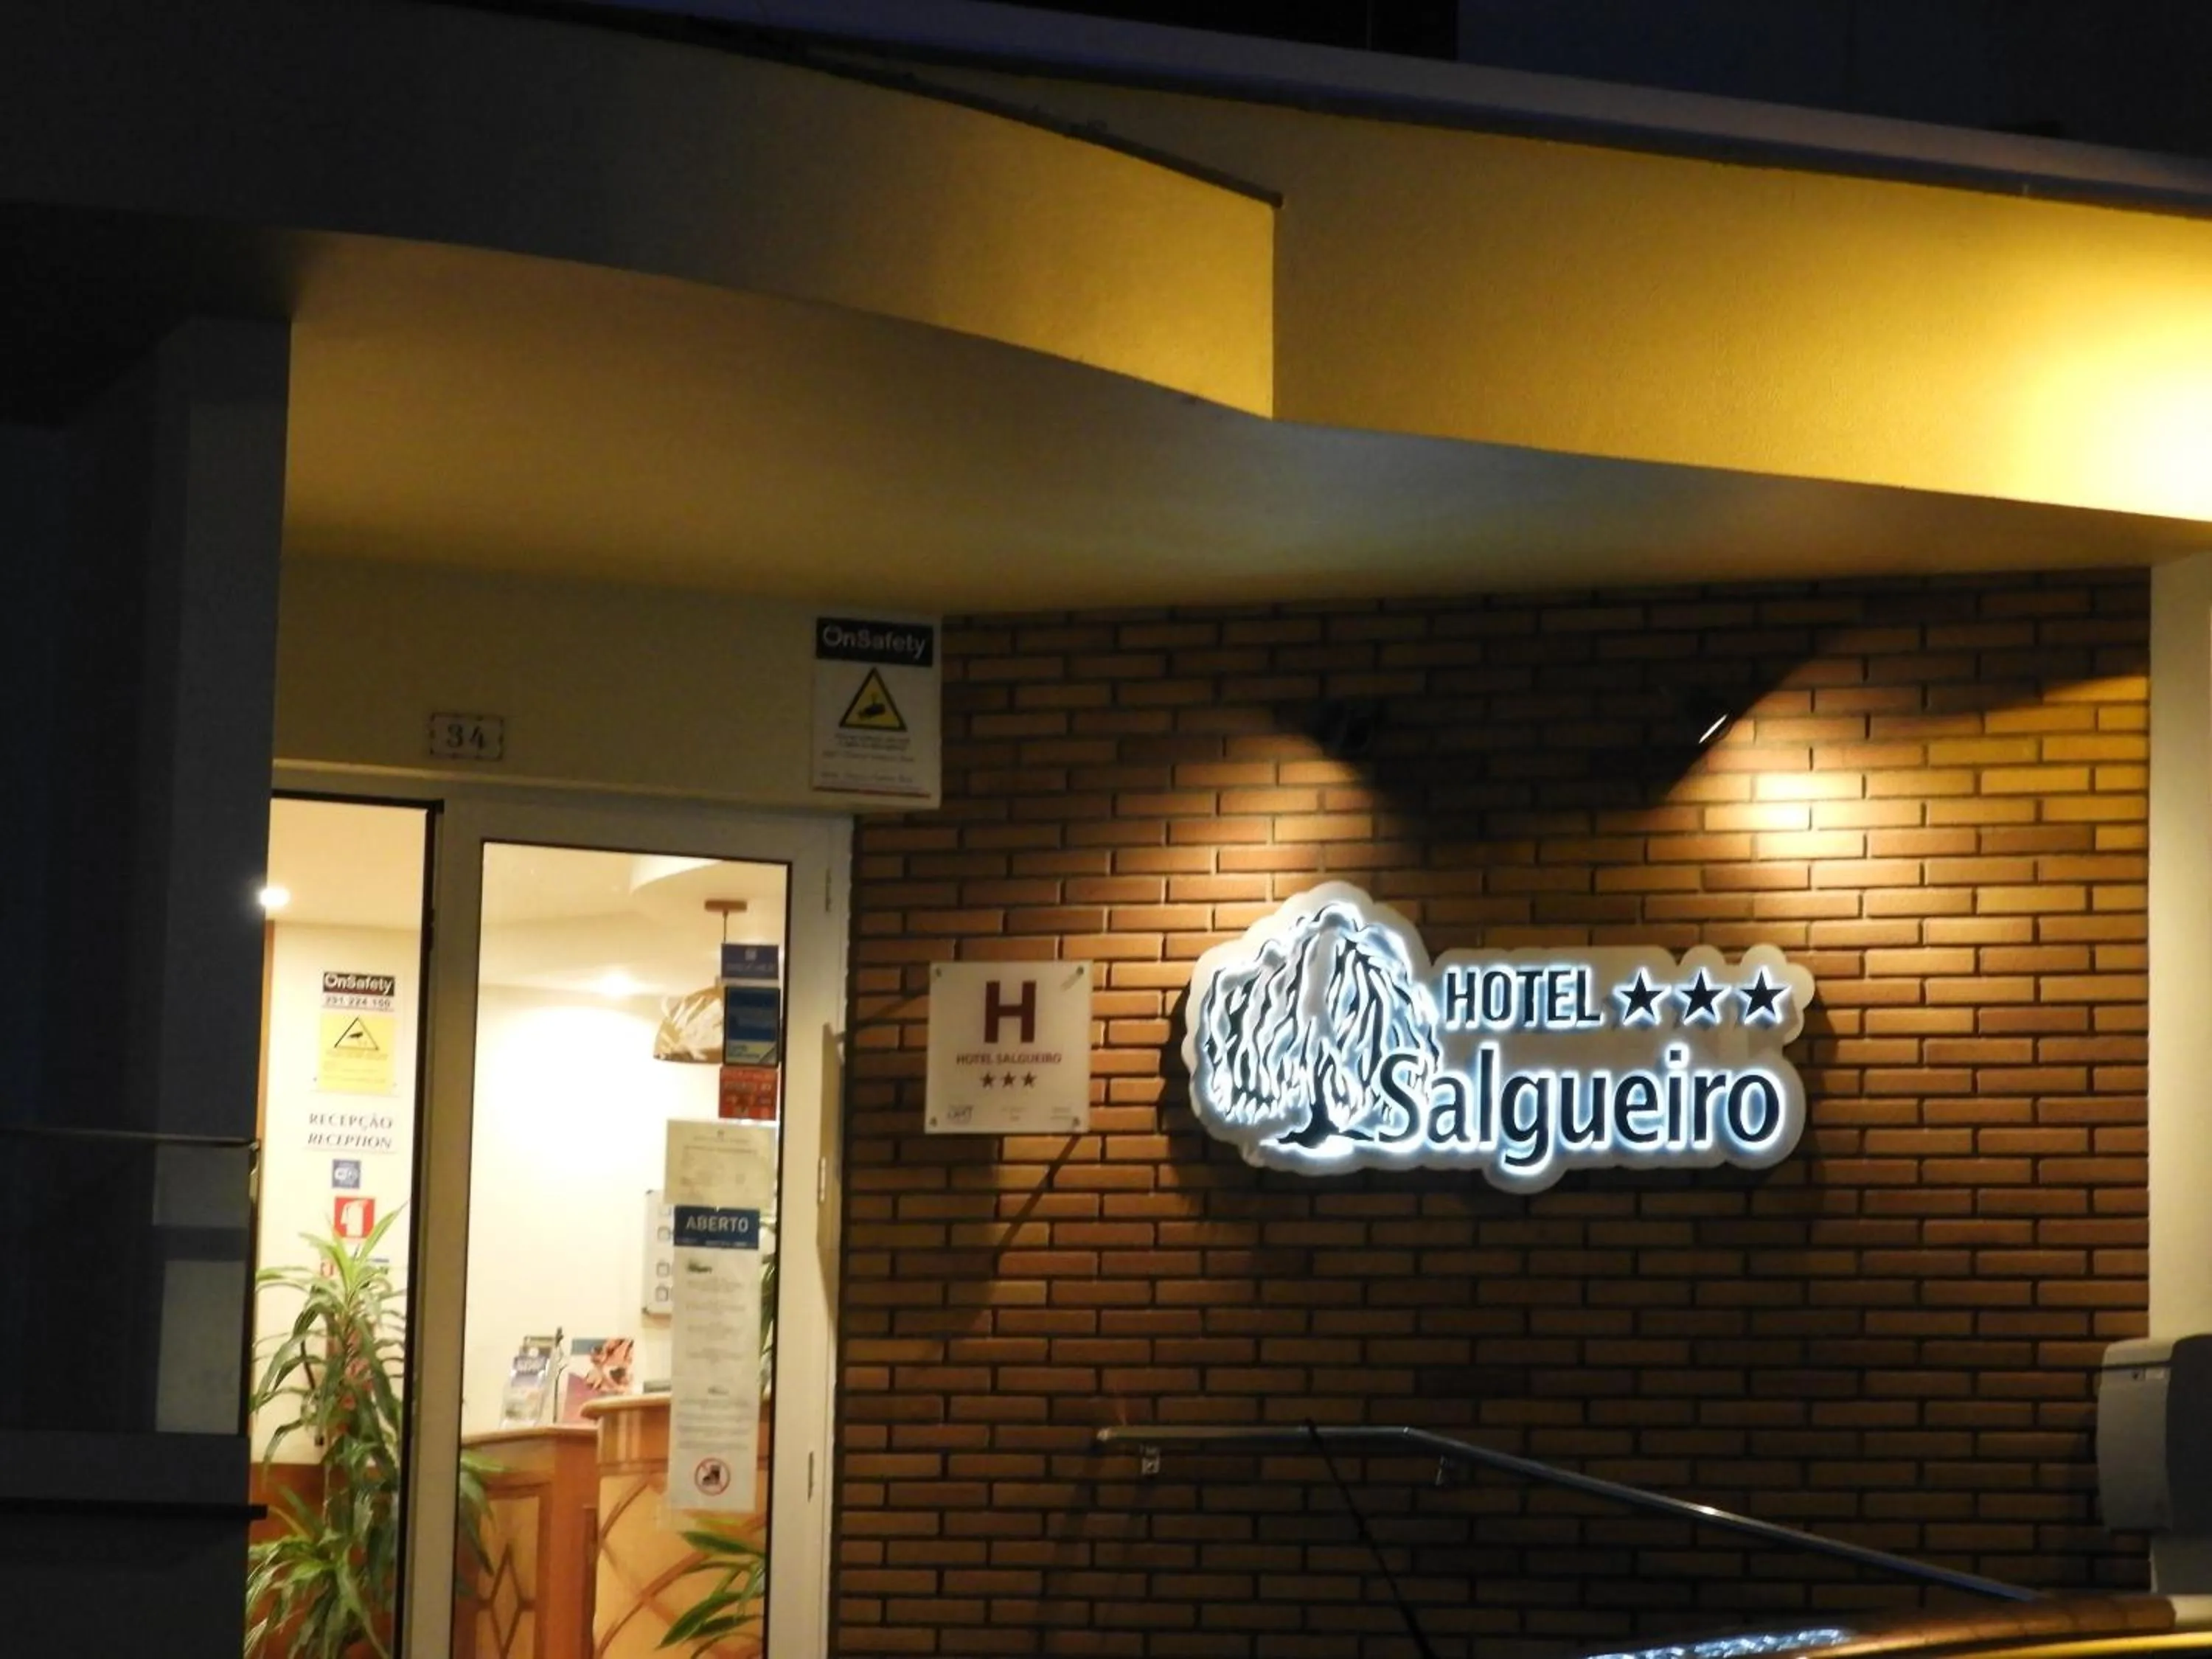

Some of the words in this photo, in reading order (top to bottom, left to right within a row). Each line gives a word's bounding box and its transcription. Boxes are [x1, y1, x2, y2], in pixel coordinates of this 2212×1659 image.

[822, 625, 925, 659] OnSafety
[446, 723, 485, 749] 34
[324, 973, 392, 995] OnSafety
[1446, 971, 1600, 1023] HOTEL
[984, 980, 1037, 1044] H
[956, 1052, 994, 1065] HOTEL
[996, 1052, 1062, 1065] SALGUEIRO
[1376, 1047, 1781, 1165] Salgueiro
[307, 1133, 392, 1150] RECEPTION
[685, 1214, 749, 1234] ABERTO
